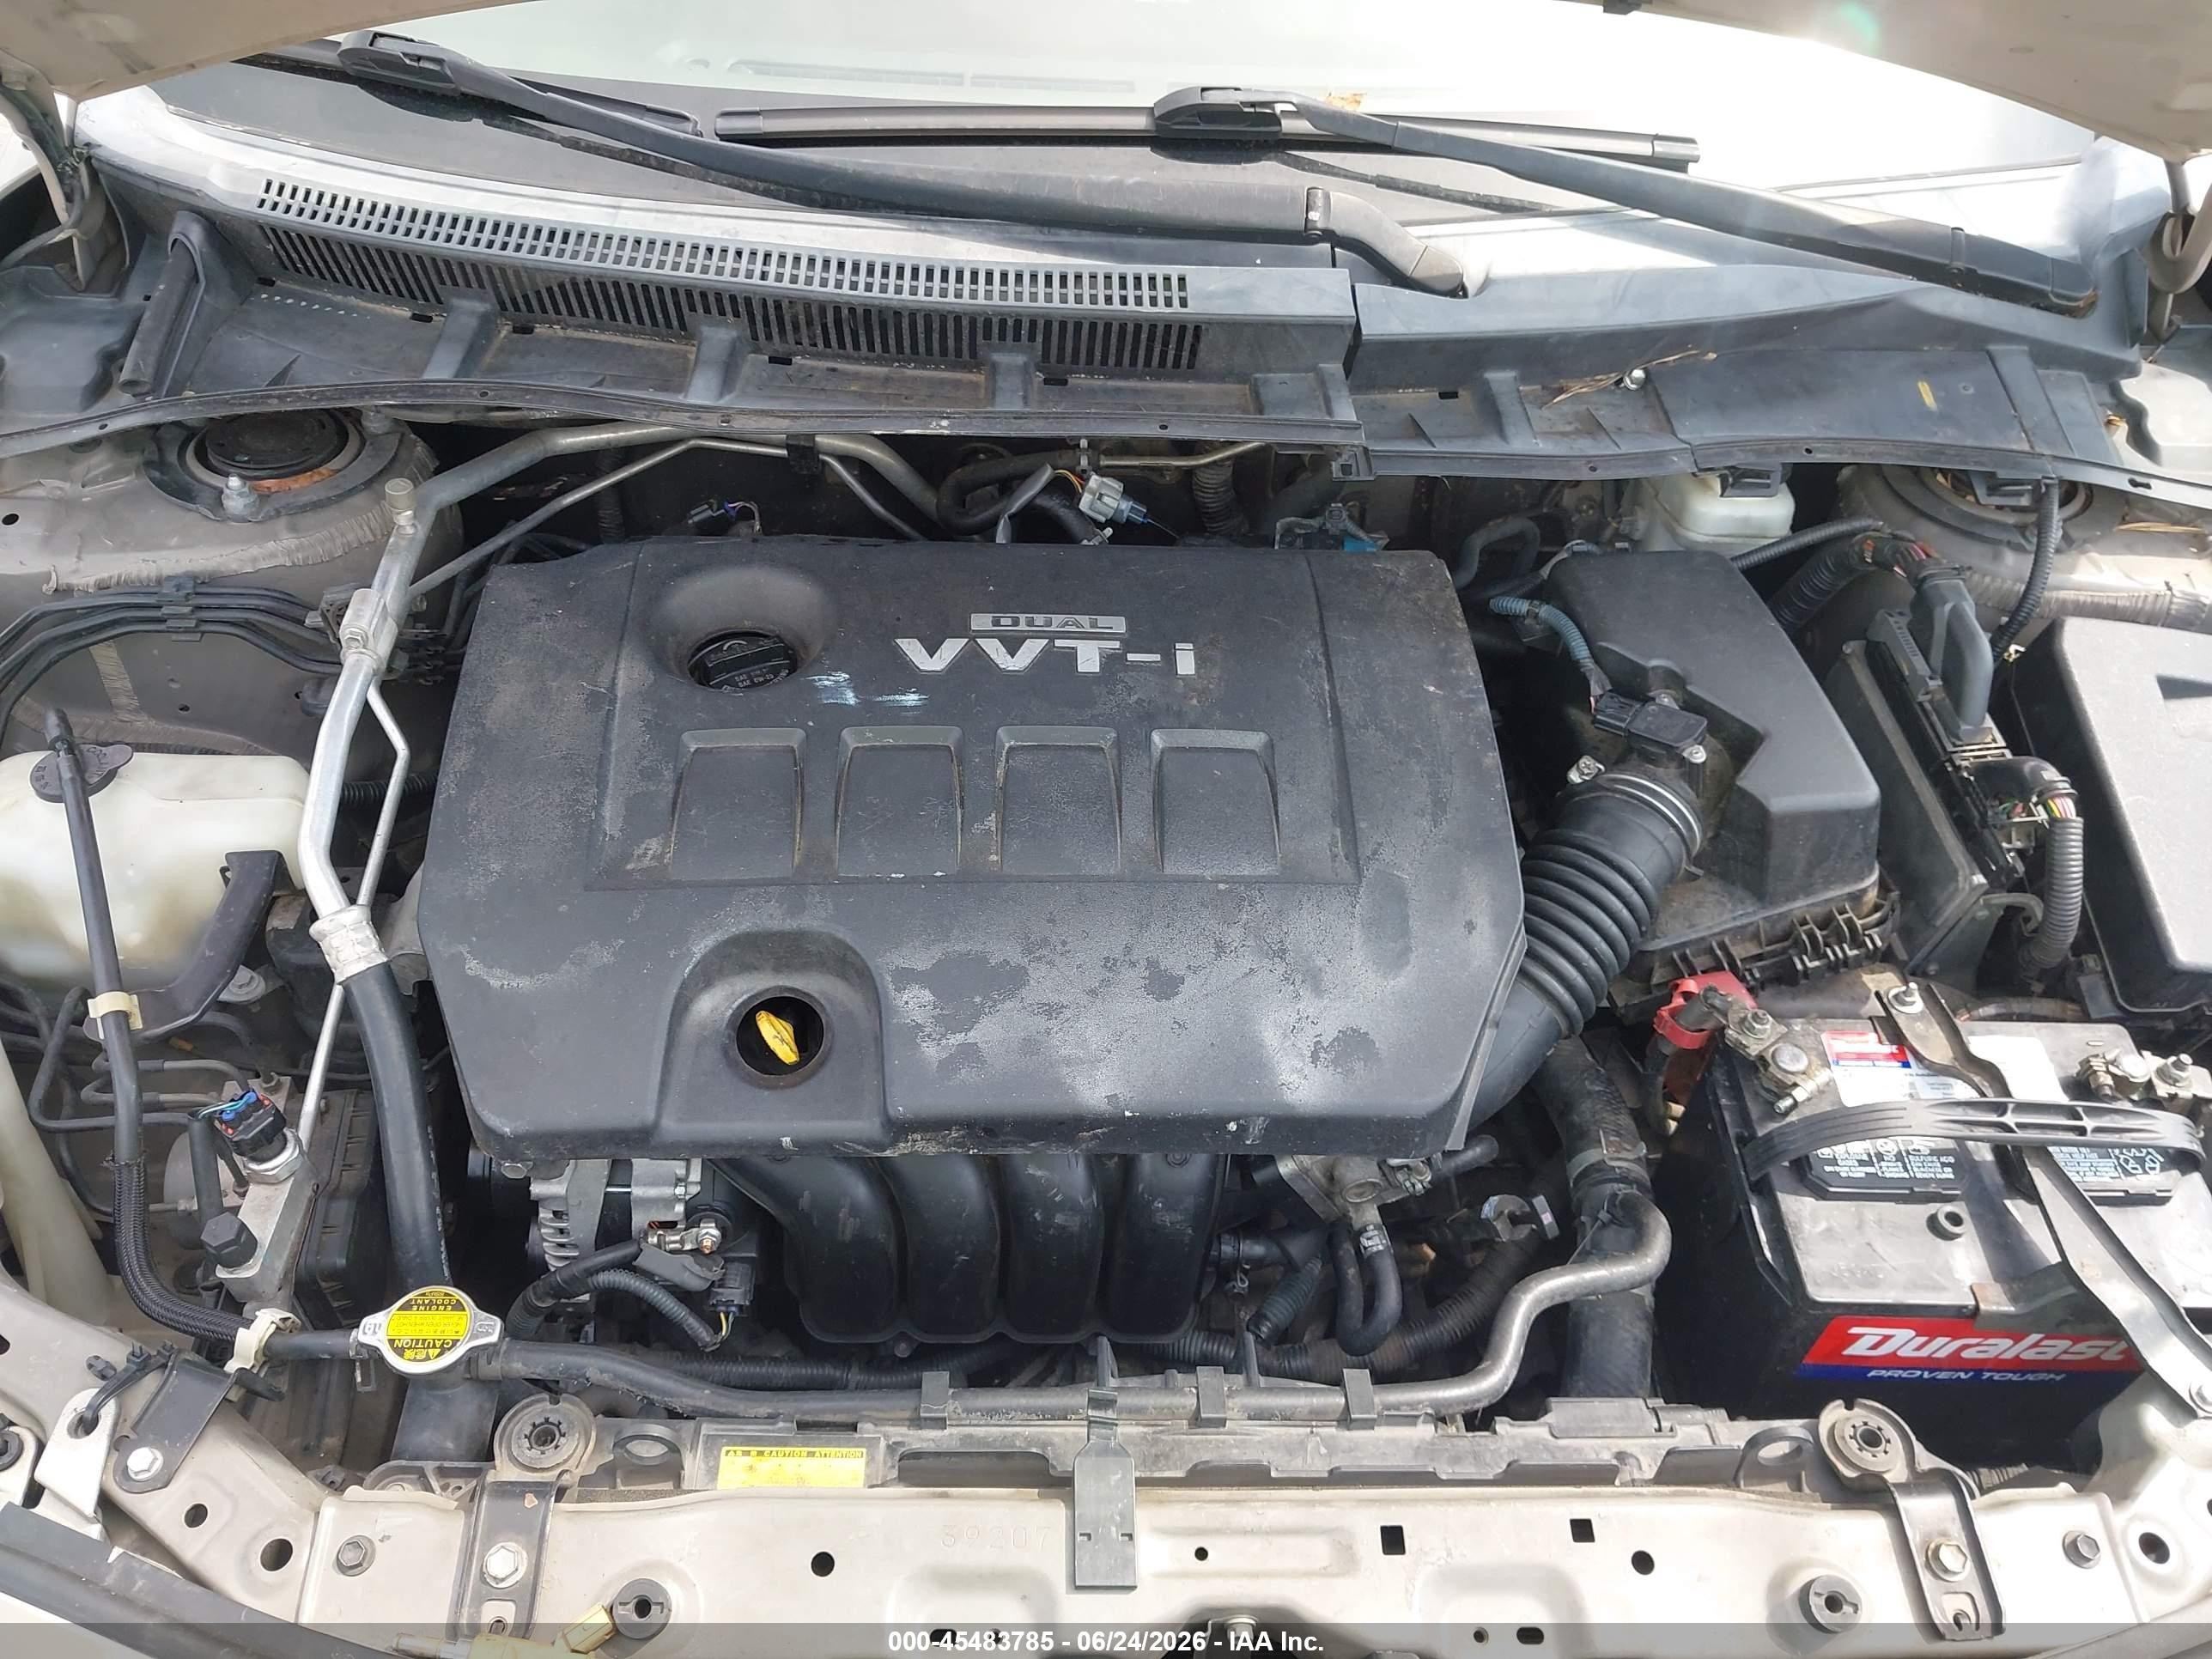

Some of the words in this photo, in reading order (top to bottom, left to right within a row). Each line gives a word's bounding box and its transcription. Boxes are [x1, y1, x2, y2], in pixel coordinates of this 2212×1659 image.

[991, 616, 1115, 630] DUAL
[894, 638, 1196, 676] VVT-i
[393, 1338, 453, 1348] CAUTION
[1840, 1326, 2128, 1362] Duralast
[1866, 1368, 1975, 1381] PROVEN
[1982, 1370, 2066, 1382] TOUGH
[763, 1449, 808, 1458] CAUTION
[815, 1449, 862, 1459] ATTENTION
